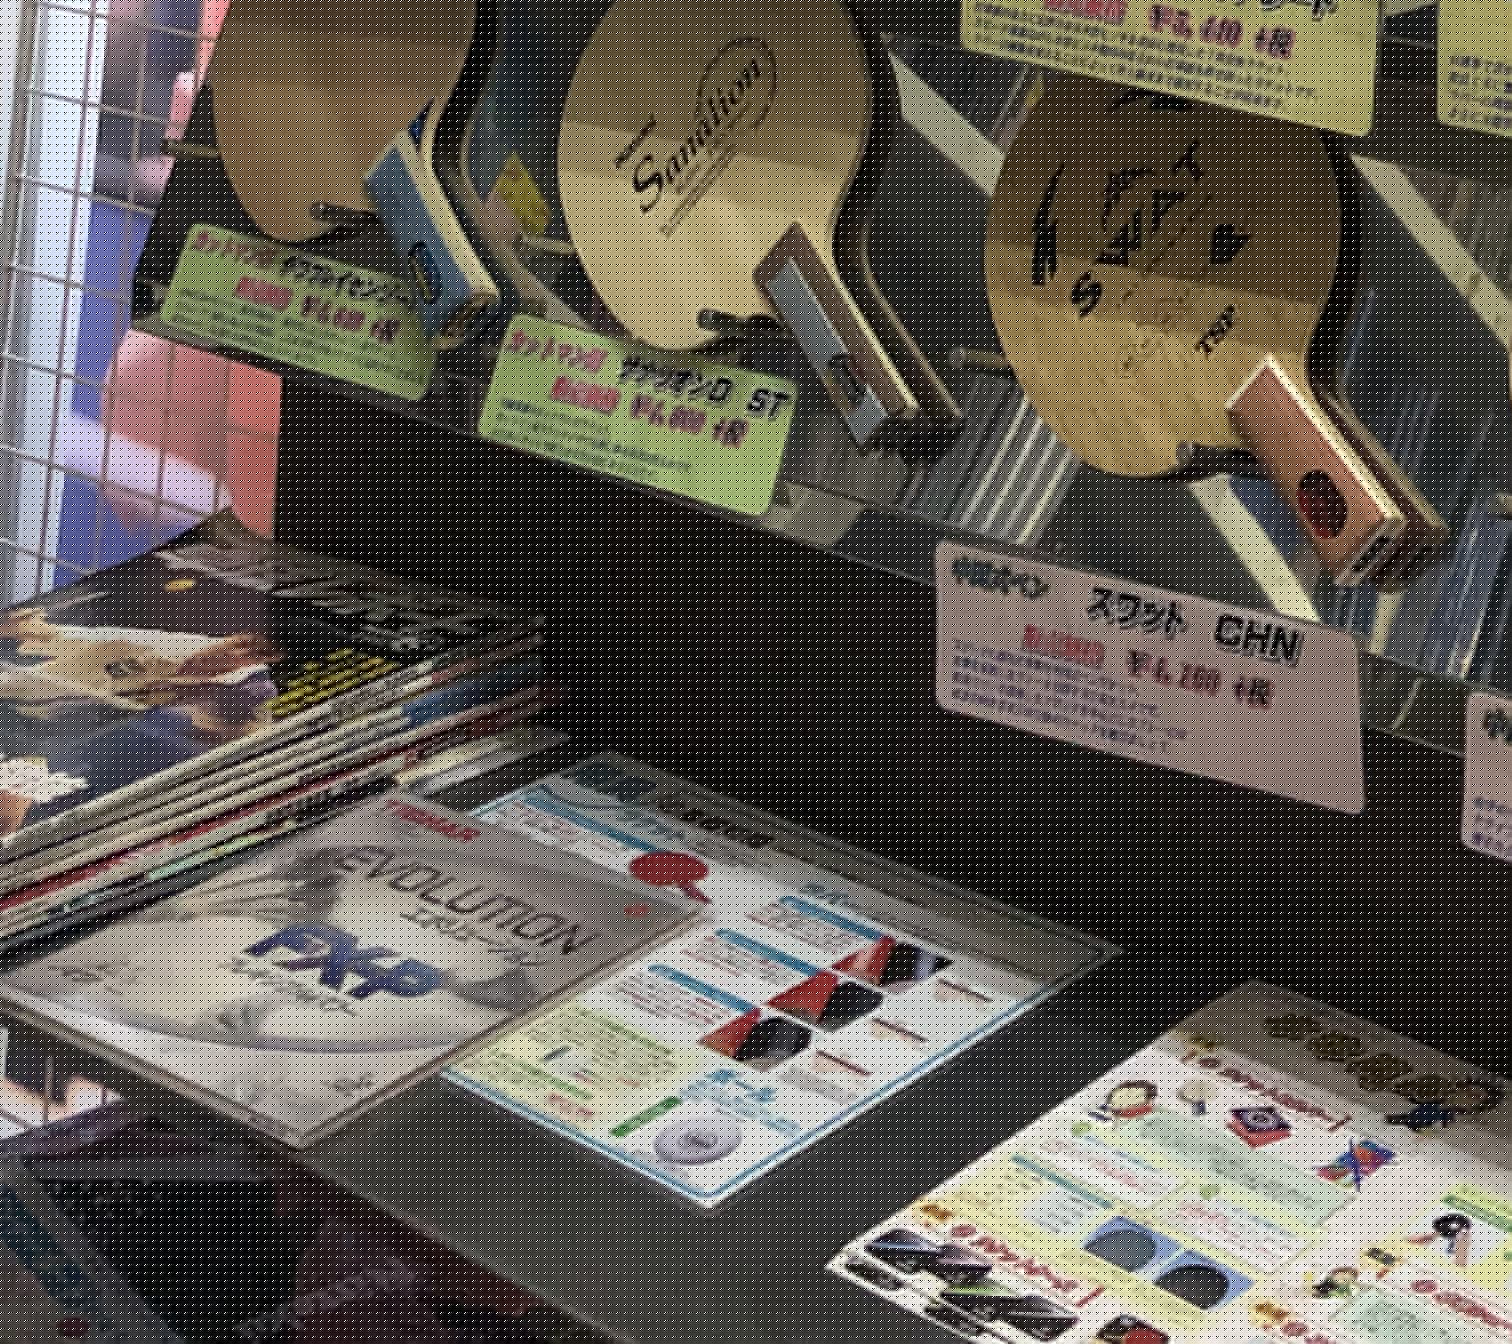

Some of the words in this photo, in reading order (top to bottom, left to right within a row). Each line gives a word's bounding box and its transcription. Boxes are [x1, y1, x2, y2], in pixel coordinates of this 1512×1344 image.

[1068, 138, 1210, 320] SWAT
[745, 387, 795, 423] ST
[1084, 584, 1190, 641] スワット
[1212, 613, 1307, 670] CHN
[335, 845, 601, 959] EVOLUTION
